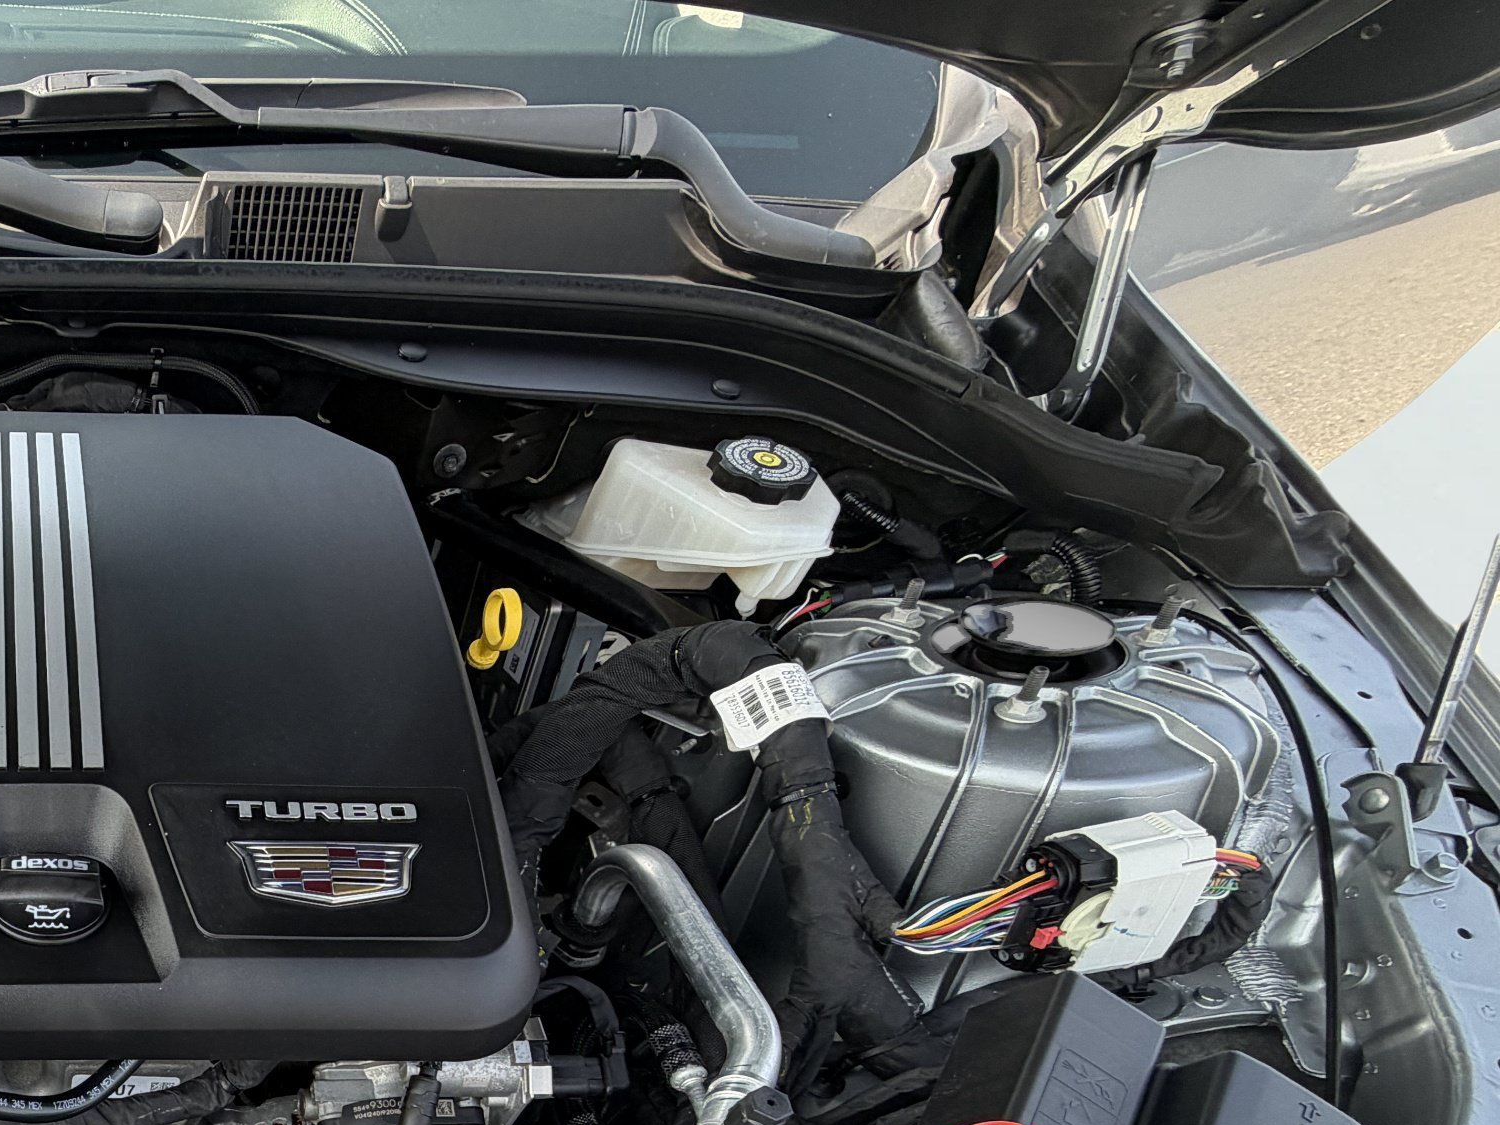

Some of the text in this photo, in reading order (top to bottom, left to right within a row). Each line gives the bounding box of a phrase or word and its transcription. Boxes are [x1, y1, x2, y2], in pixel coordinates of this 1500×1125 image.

[226, 800, 417, 822] TURBO
[11, 856, 90, 870] dexos
[11, 1099, 25, 1109] 345
[28, 1101, 43, 1110] MEX
